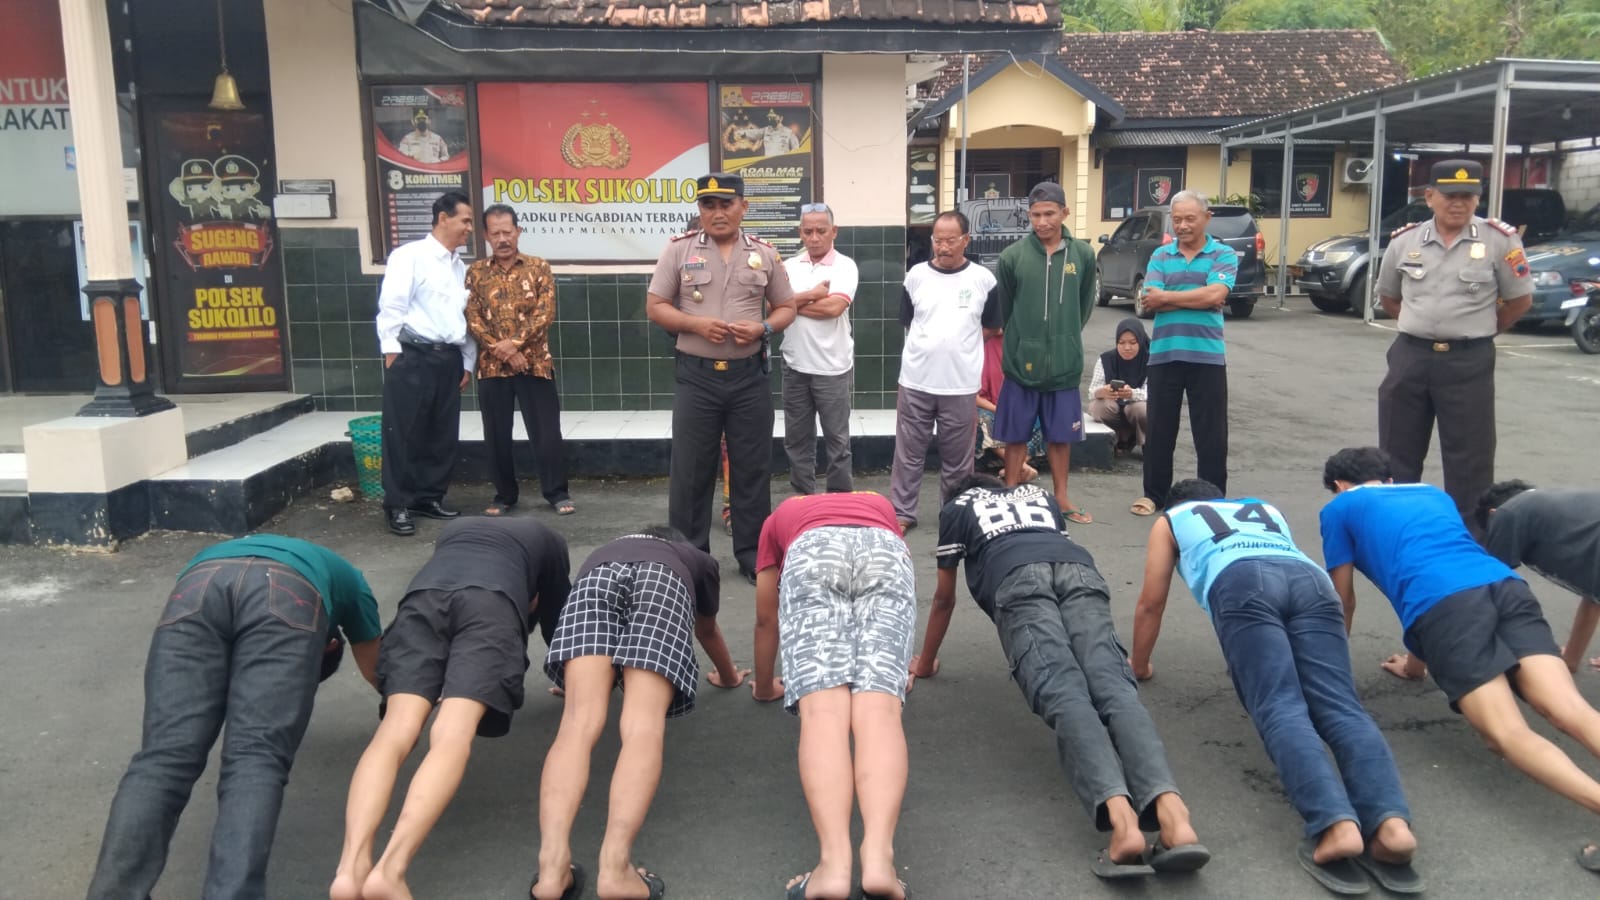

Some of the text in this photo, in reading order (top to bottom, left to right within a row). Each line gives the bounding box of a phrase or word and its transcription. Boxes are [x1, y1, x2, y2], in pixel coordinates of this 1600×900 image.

[0, 78, 68, 101] NTUK
[0, 108, 70, 130] AKAT
[387, 169, 462, 190] 8 KOMITMEN
[493, 178, 698, 204] POLSEK SUKOLILO
[560, 212, 643, 223] PENGABDIAN
[191, 229, 259, 250] SUGENG
[660, 226, 688, 234] AND
[203, 251, 251, 267] RAWUH
[195, 287, 265, 308] POLSEK
[188, 307, 276, 329] SUKOLILO
[972, 497, 1057, 534] 86
[1191, 503, 1282, 545] 14
